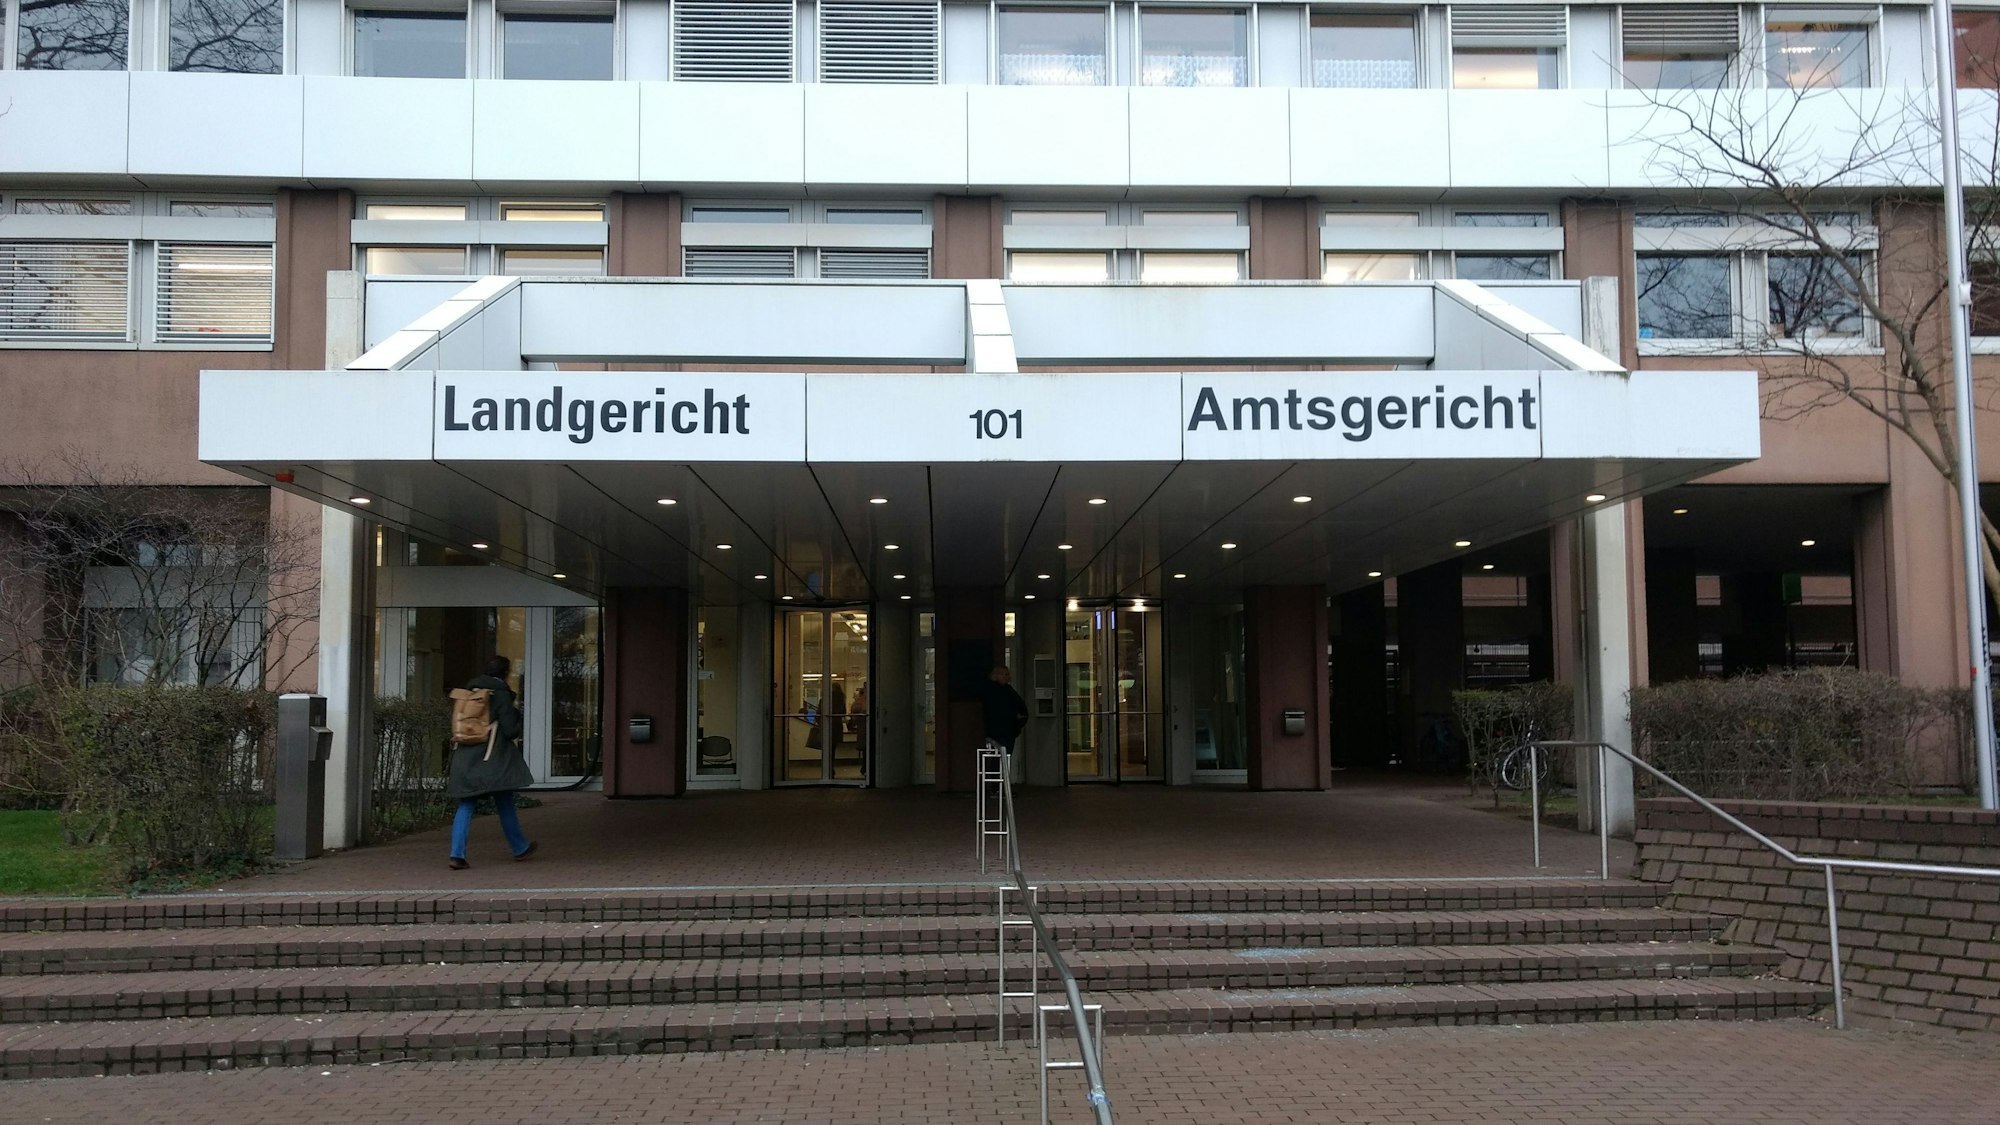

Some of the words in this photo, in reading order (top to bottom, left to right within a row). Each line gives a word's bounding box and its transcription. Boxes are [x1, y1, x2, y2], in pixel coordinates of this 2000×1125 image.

[445, 386, 750, 444] Landgericht
[970, 409, 1021, 439] 101
[1188, 386, 1536, 441] Amtsgericht
